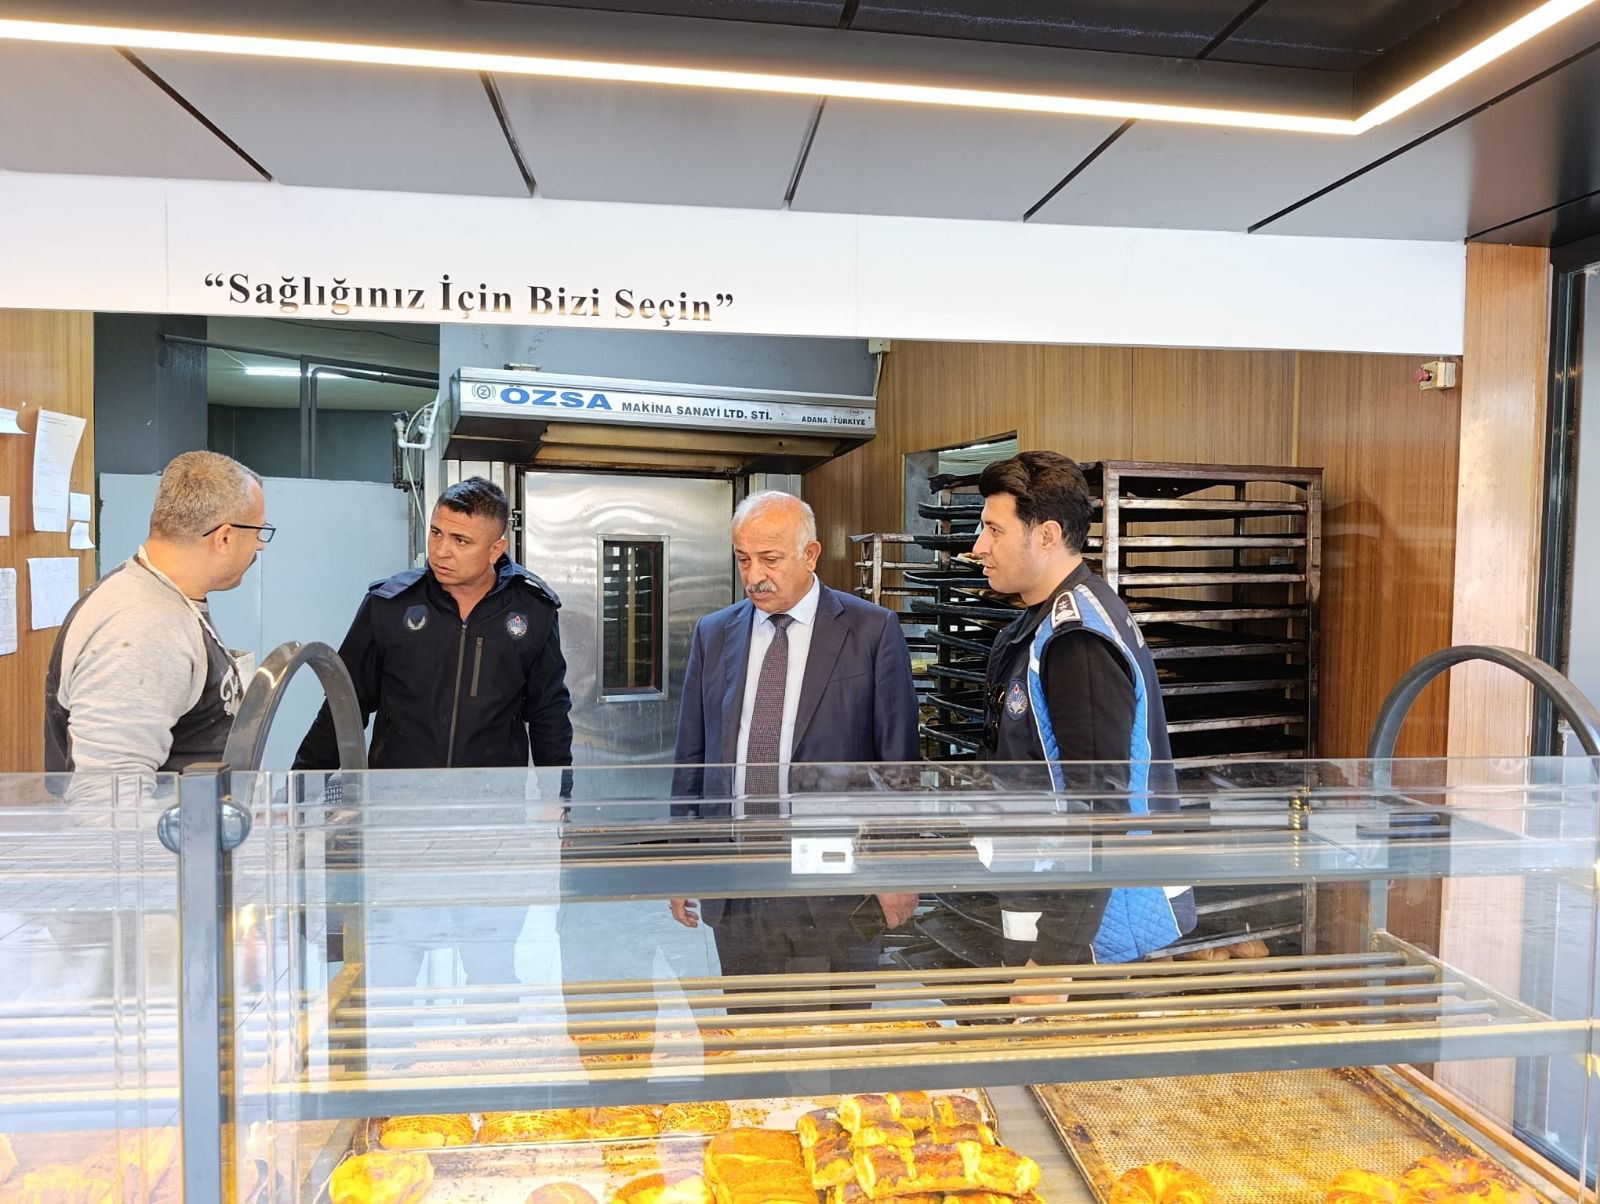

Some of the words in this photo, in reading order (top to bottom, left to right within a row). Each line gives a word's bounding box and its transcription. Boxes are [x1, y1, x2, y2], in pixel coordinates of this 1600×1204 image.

[204, 272, 425, 315] “Sağlığınız
[439, 274, 512, 319] İçin
[527, 285, 601, 316] Bizi
[614, 289, 734, 327] Seçin”
[500, 384, 613, 411] ÖZSA
[676, 406, 721, 417] SANAYİ
[723, 409, 748, 419] LTD.
[801, 416, 828, 424] ADANA
